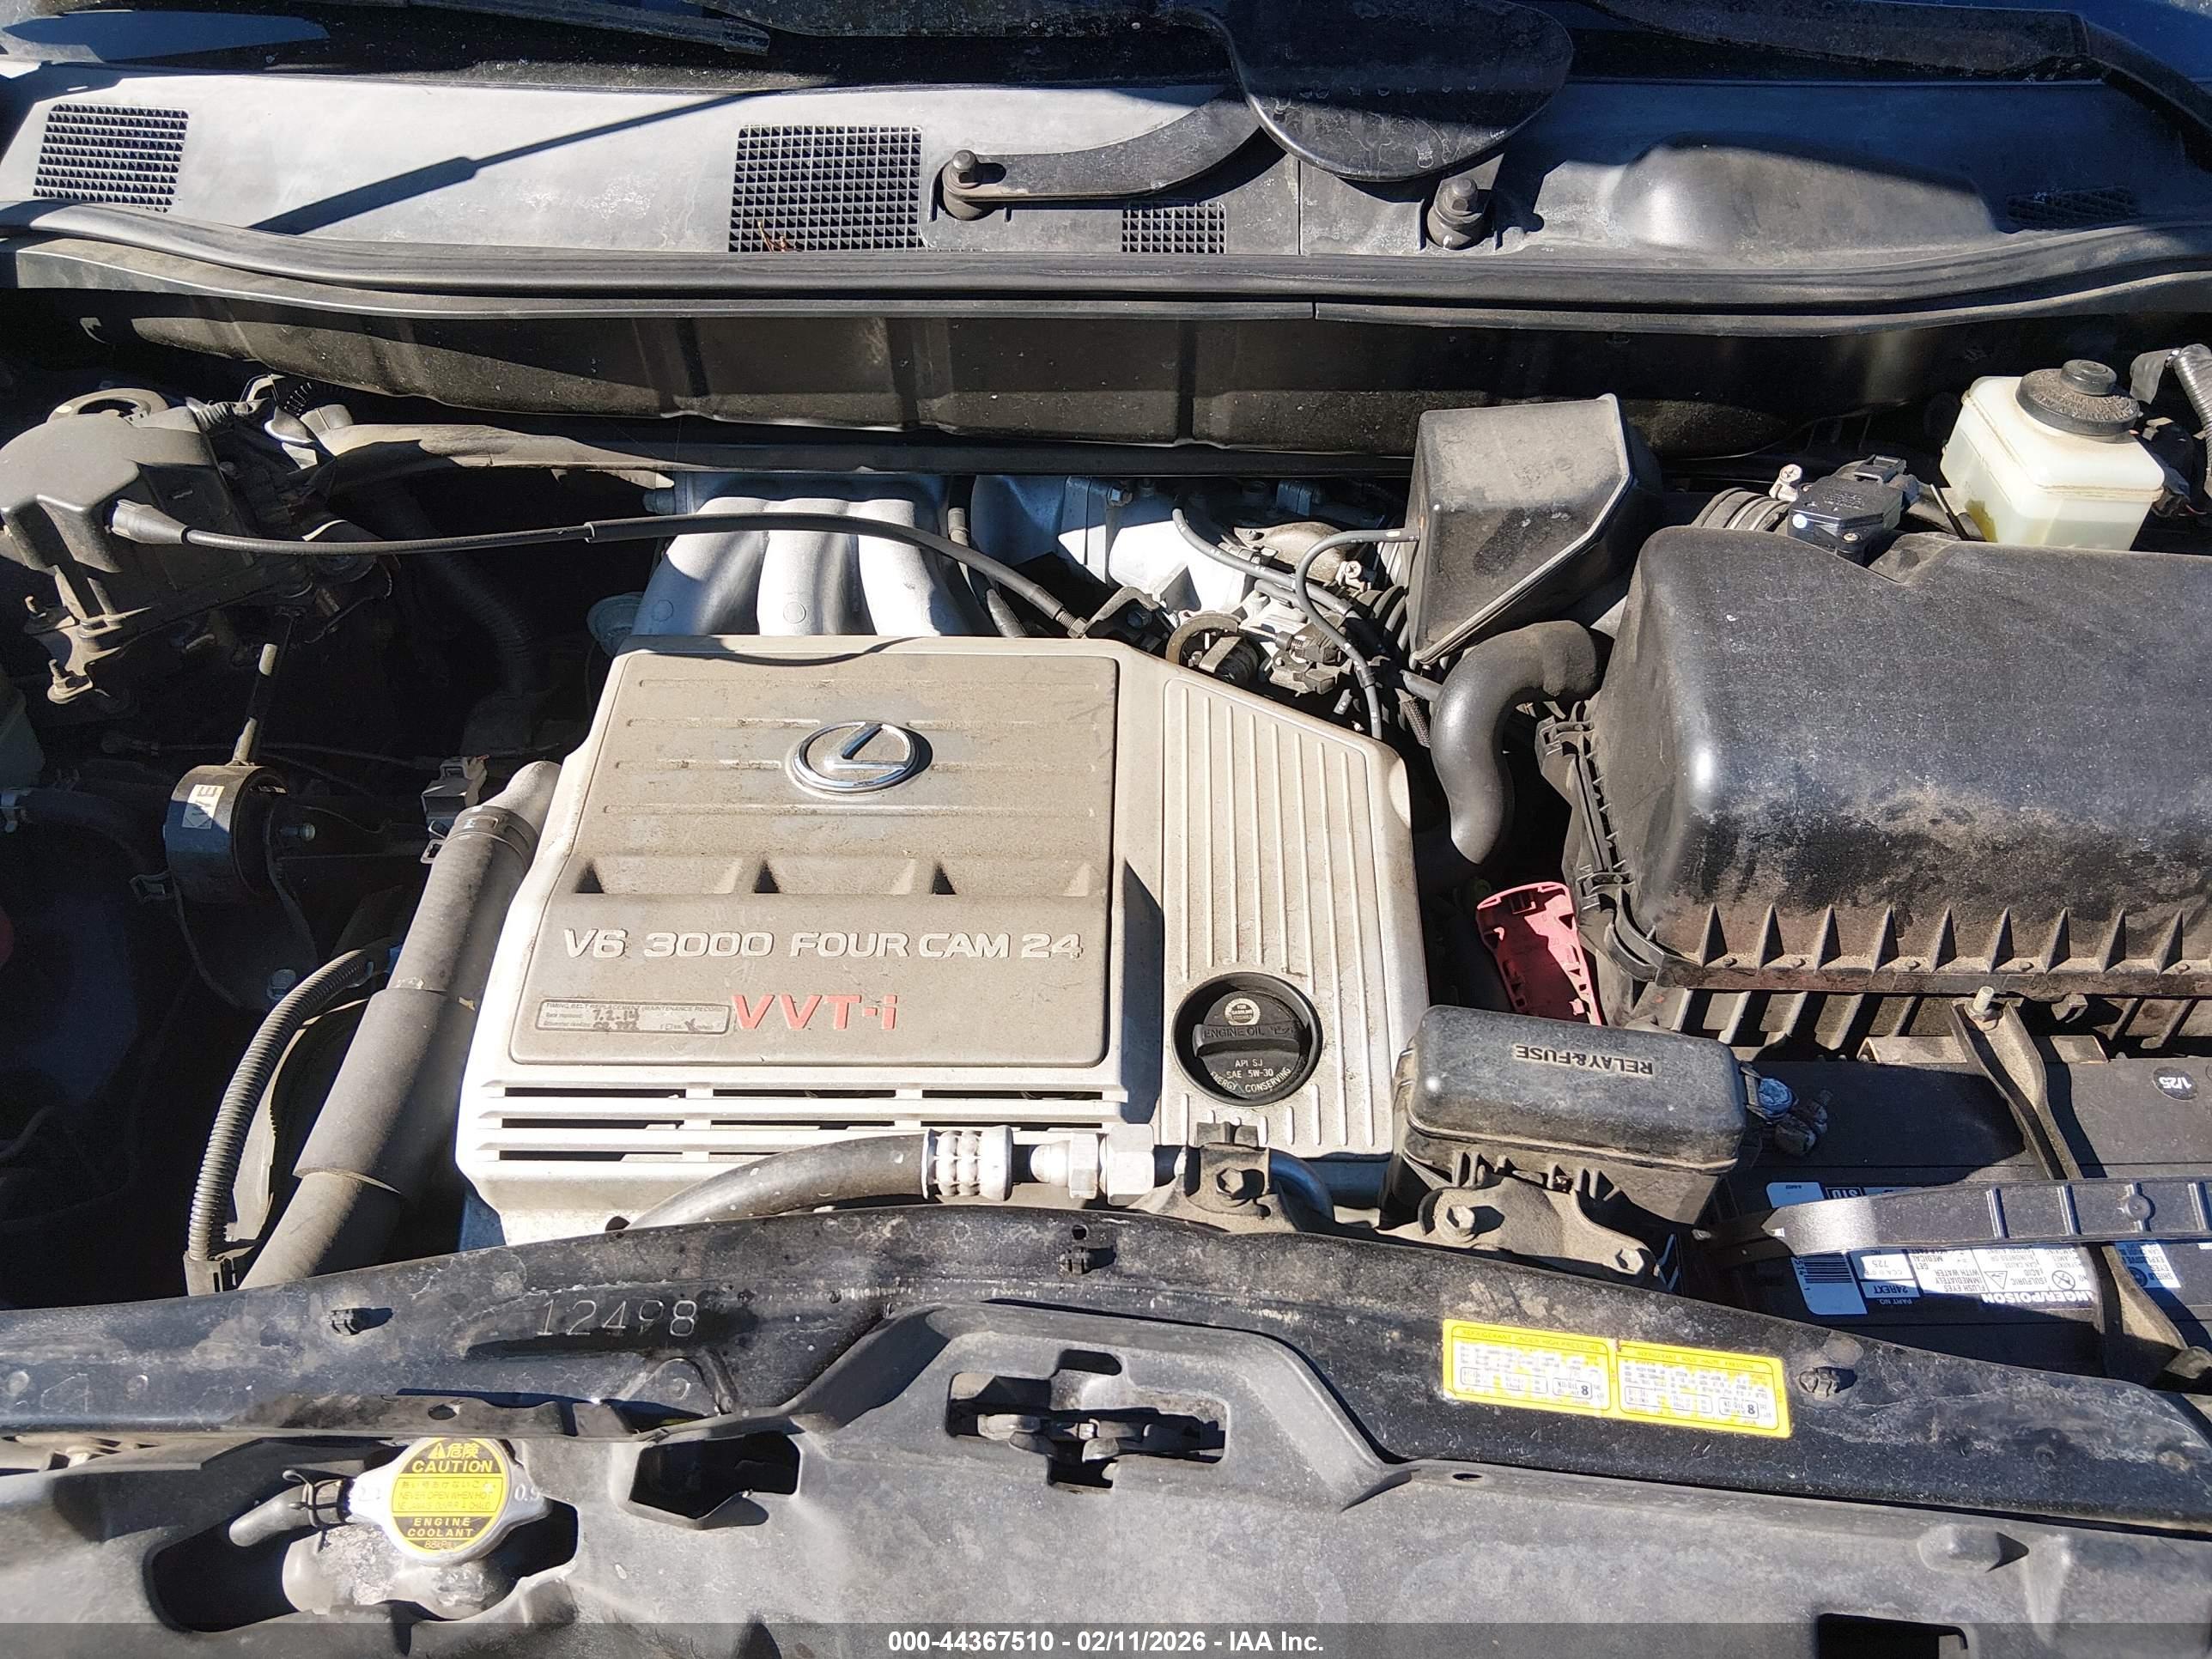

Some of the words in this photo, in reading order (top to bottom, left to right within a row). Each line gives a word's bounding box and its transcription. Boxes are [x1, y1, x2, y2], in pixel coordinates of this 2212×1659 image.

[563, 927, 629, 959] V6
[644, 931, 775, 959] 3000
[789, 932, 911, 958] FOUR
[918, 933, 1011, 959] CAM
[1022, 933, 1085, 960] 24
[732, 994, 899, 1032] VVT-i
[1204, 1028, 1245, 1039] ENGINE
[1246, 1026, 1265, 1036] OIL
[1515, 1045, 1654, 1075] RELAY&FUSE
[1210, 1071, 1238, 1091] ENERGY
[1245, 1066, 1291, 1093] CONSERVING
[1226, 1070, 1243, 1079] SAE
[1248, 1068, 1274, 1078] 5W-30
[2159, 1076, 2192, 1090] 1/25
[1872, 1259, 1888, 1268] 725
[1873, 1285, 1908, 1294] 24REXT
[1980, 1291, 2094, 1304] ANGER/POISON
[1581, 1385, 1589, 1395] 8
[1747, 1404, 1756, 1414] 8
[447, 1442, 480, 1458] 危険
[412, 1460, 493, 1473] CAUTION
[414, 1517, 471, 1526] ENGINE
[407, 1528, 474, 1537] COOLANT
